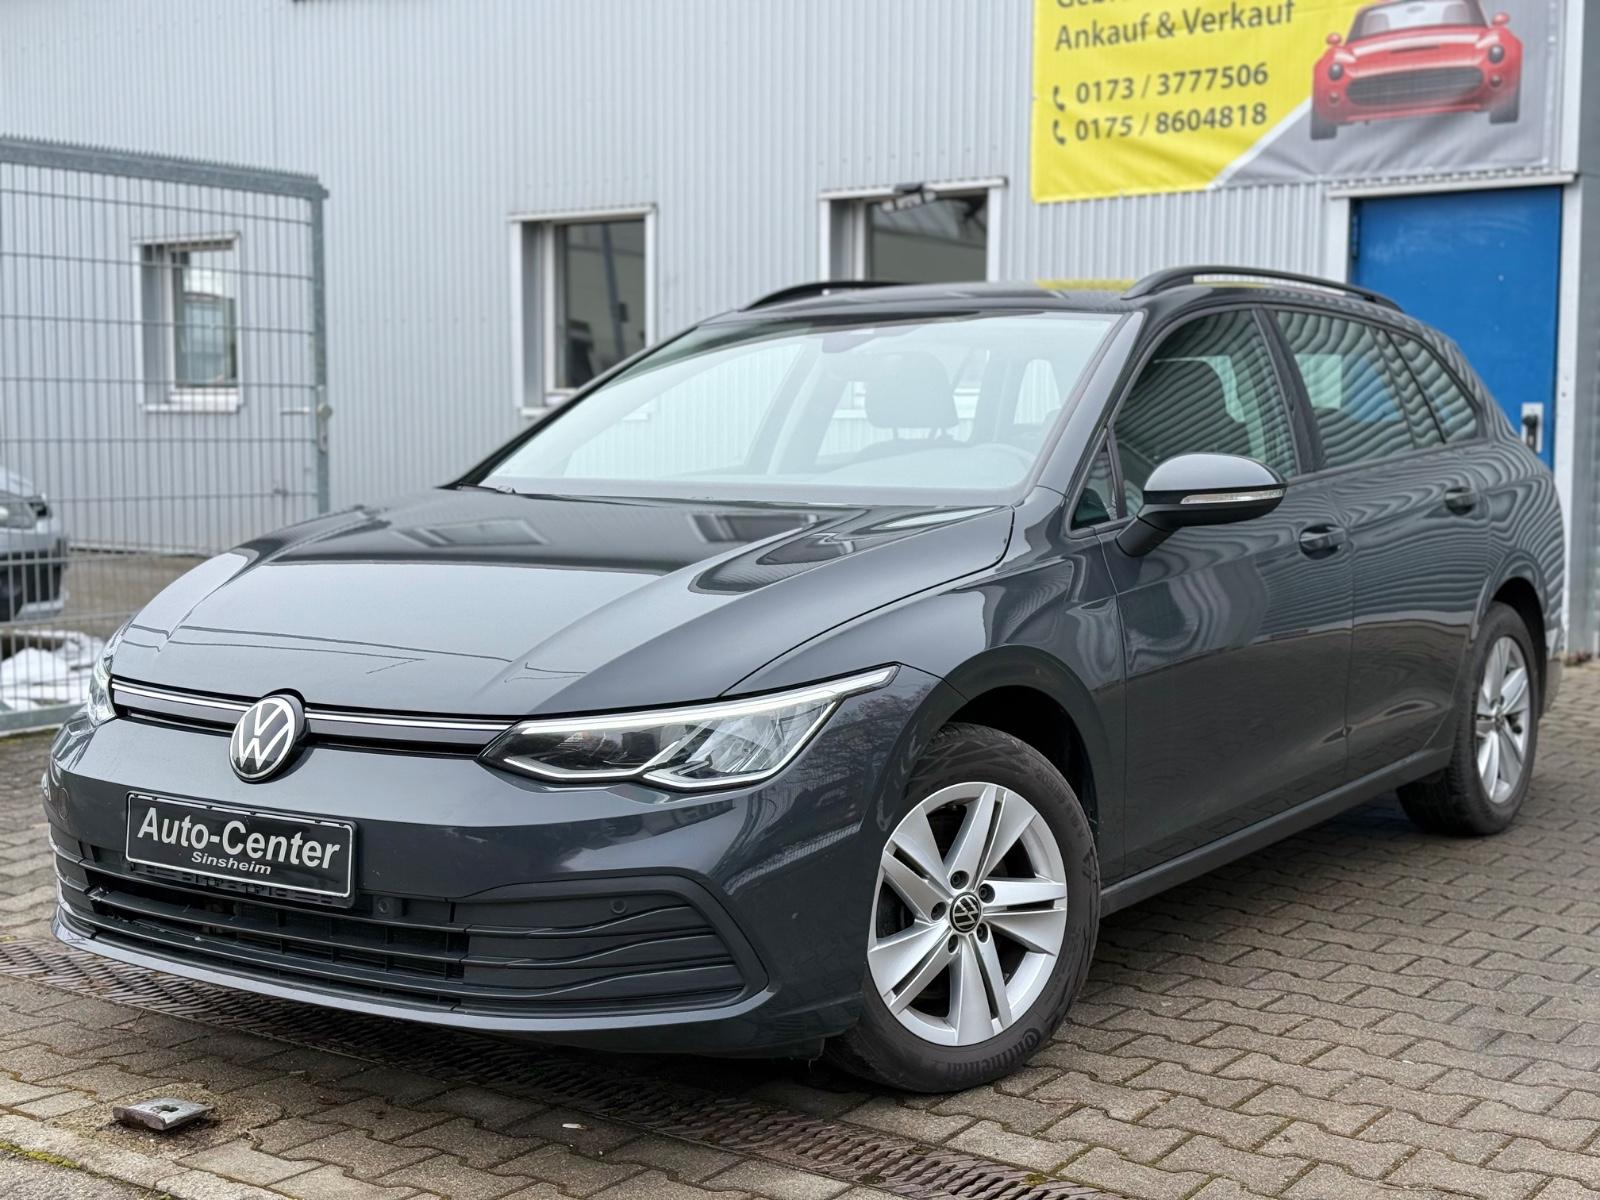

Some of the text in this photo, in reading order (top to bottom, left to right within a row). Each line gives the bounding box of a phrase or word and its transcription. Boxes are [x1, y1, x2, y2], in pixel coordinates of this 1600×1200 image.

[1055, 0, 1295, 50] Ankauf & Verkauf
[1076, 77, 1134, 104] 0173
[1157, 62, 1268, 96] 3777506
[1075, 115, 1133, 141] 0175
[1155, 102, 1267, 134] 8604818
[137, 807, 341, 869] Auto-Center
[191, 851, 272, 876] Sinsheim
[946, 1028, 1041, 1077] Continental
